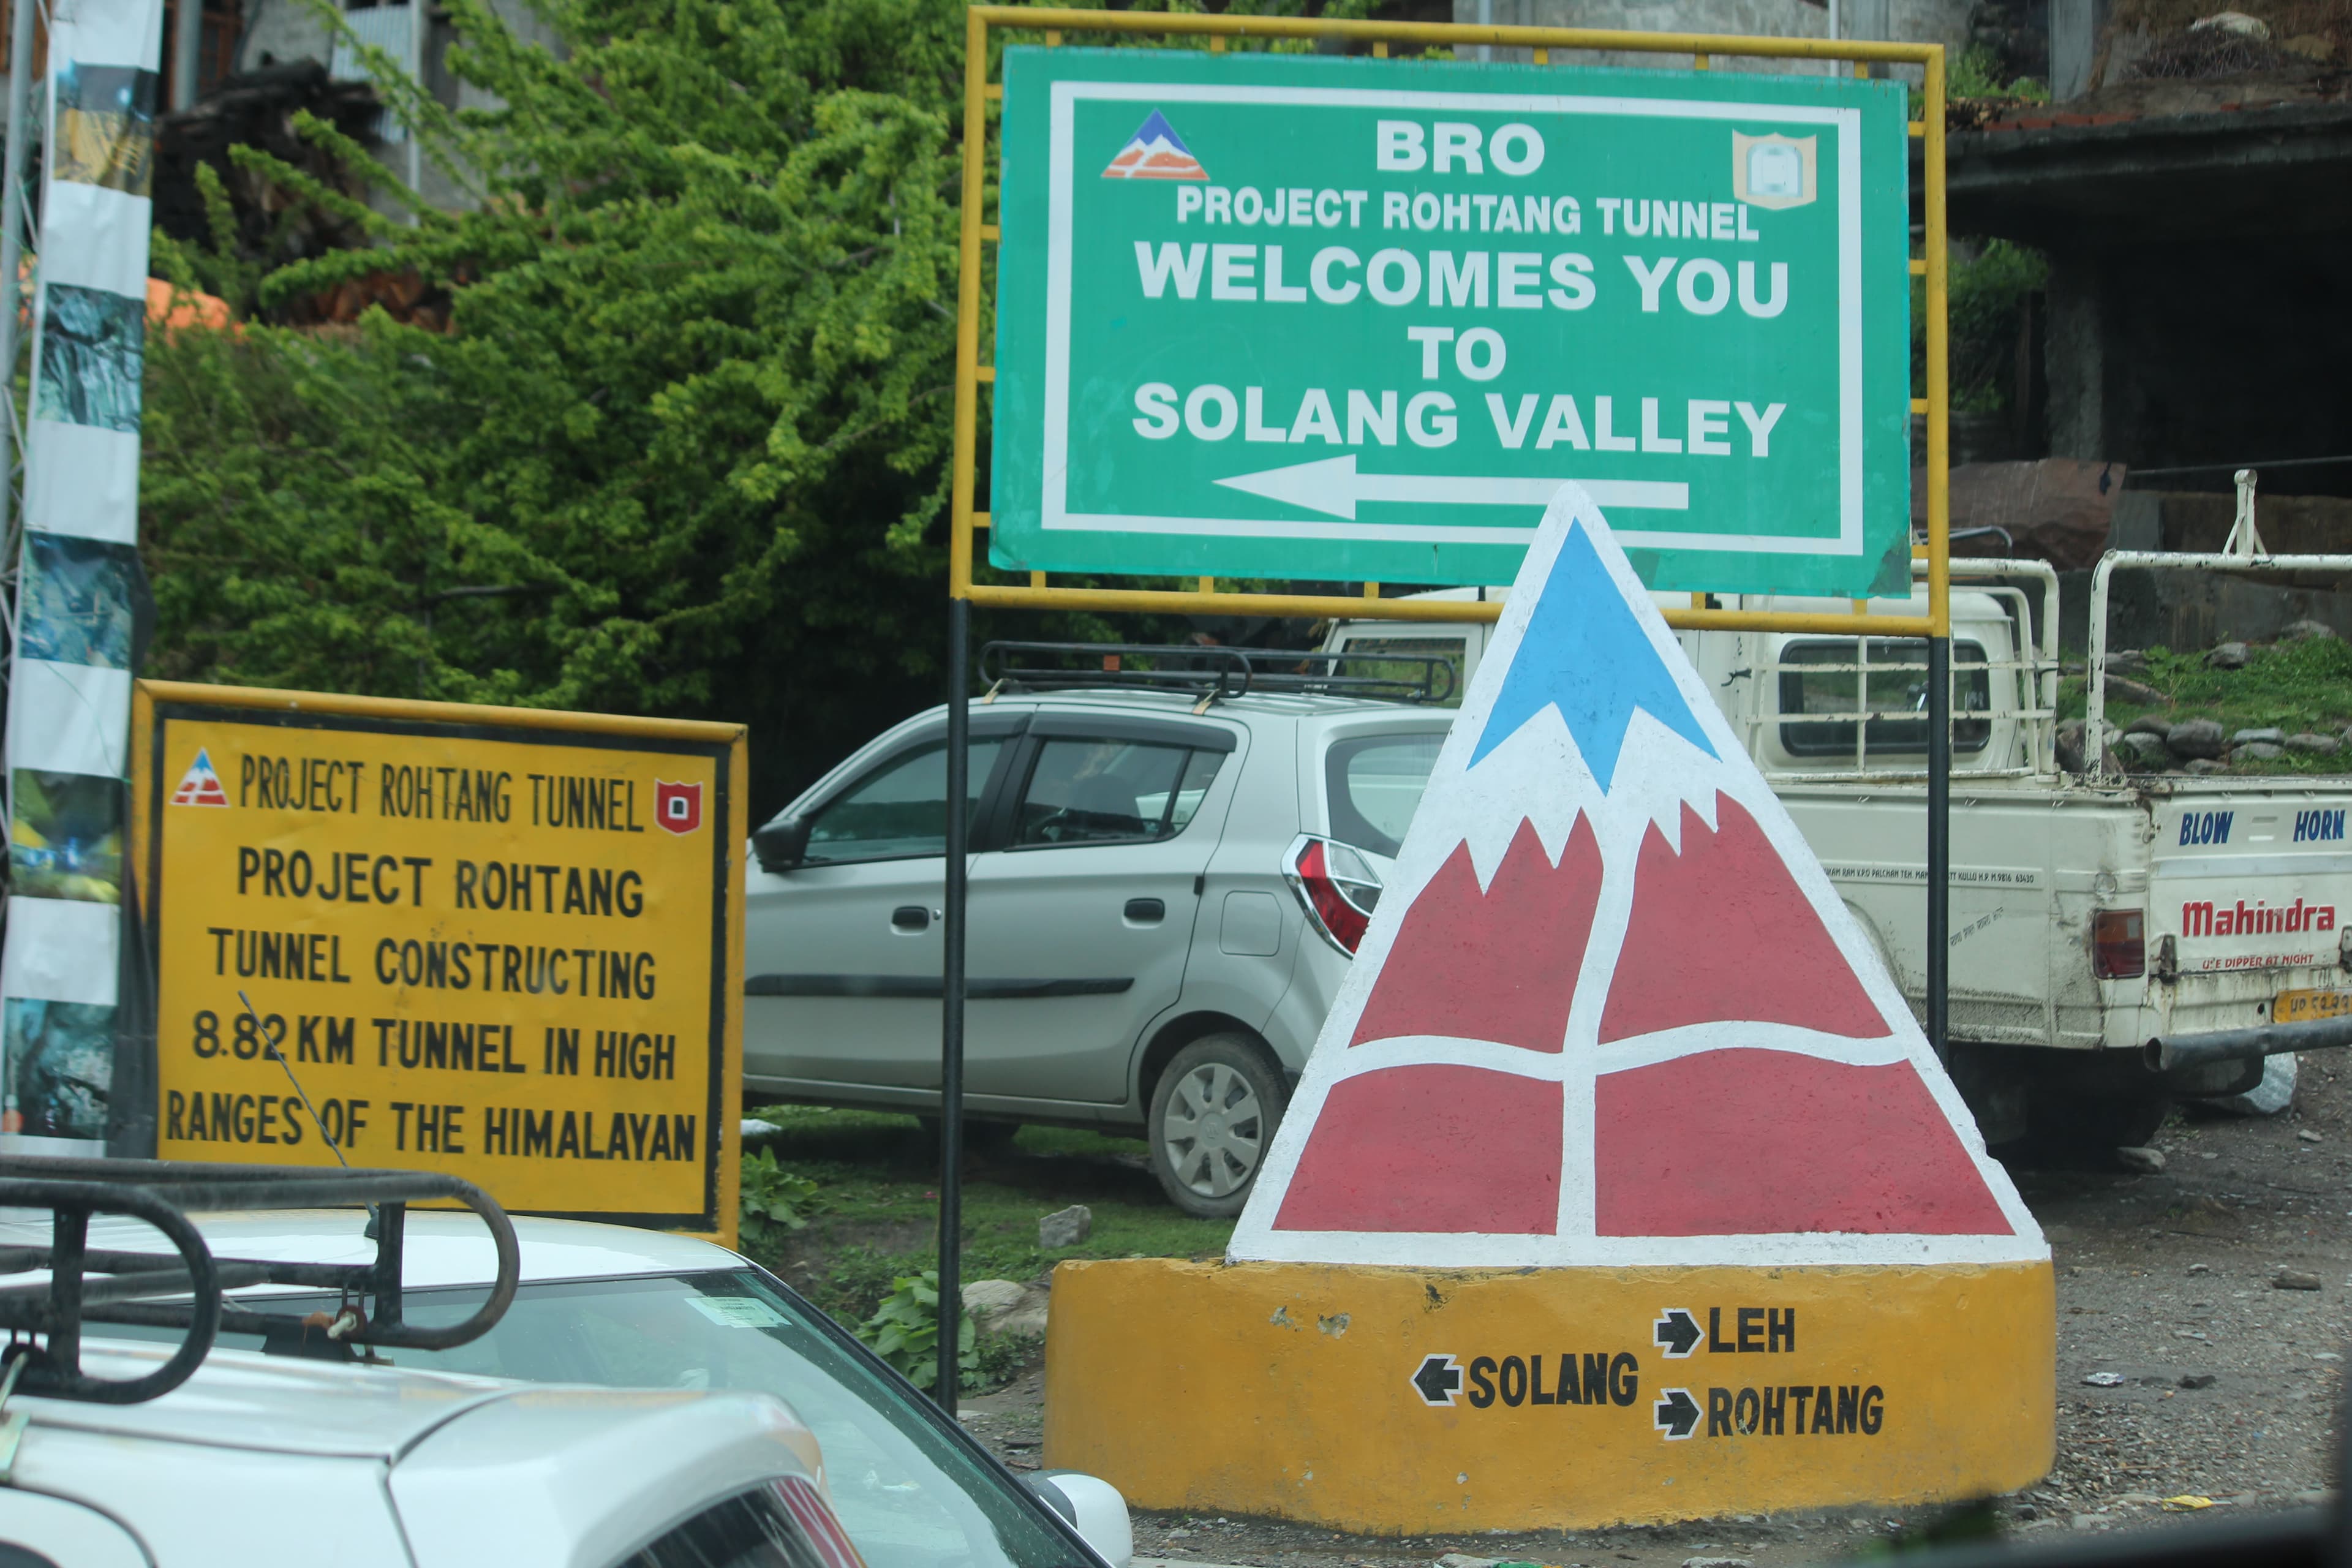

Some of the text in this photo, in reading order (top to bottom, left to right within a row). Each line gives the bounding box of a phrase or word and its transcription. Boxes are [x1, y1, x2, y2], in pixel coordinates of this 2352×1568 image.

[1376, 119, 1545, 176] BRO
[1177, 185, 1760, 241] PROJECT ROHTANG TUNNEL
[1134, 240, 1789, 318] WELCOMES YOU
[1407, 326, 1507, 382] TO
[1132, 382, 1787, 458] SOLANG VALLEY
[240, 753, 645, 833] PROJECT ROHTANG TUNNEL
[2179, 809, 2346, 846] BLOW HORN
[238, 846, 644, 919] PROJECT ROHTANG
[2182, 896, 2335, 938] Mahindra
[208, 927, 656, 1001] TUNNEL CONSTRUCTING
[2203, 954, 2314, 970] UE DIPPER AT NIGHT
[192, 1009, 676, 1081] 8.82 KM TUNNEL IN HIGH
[165, 1089, 696, 1163] RANGES OF THE HIMALAYAN
[1708, 1306, 1795, 1354] LEH
[1467, 1351, 1640, 1409] SOLANG
[1707, 1384, 1885, 1438] ROHTANG
